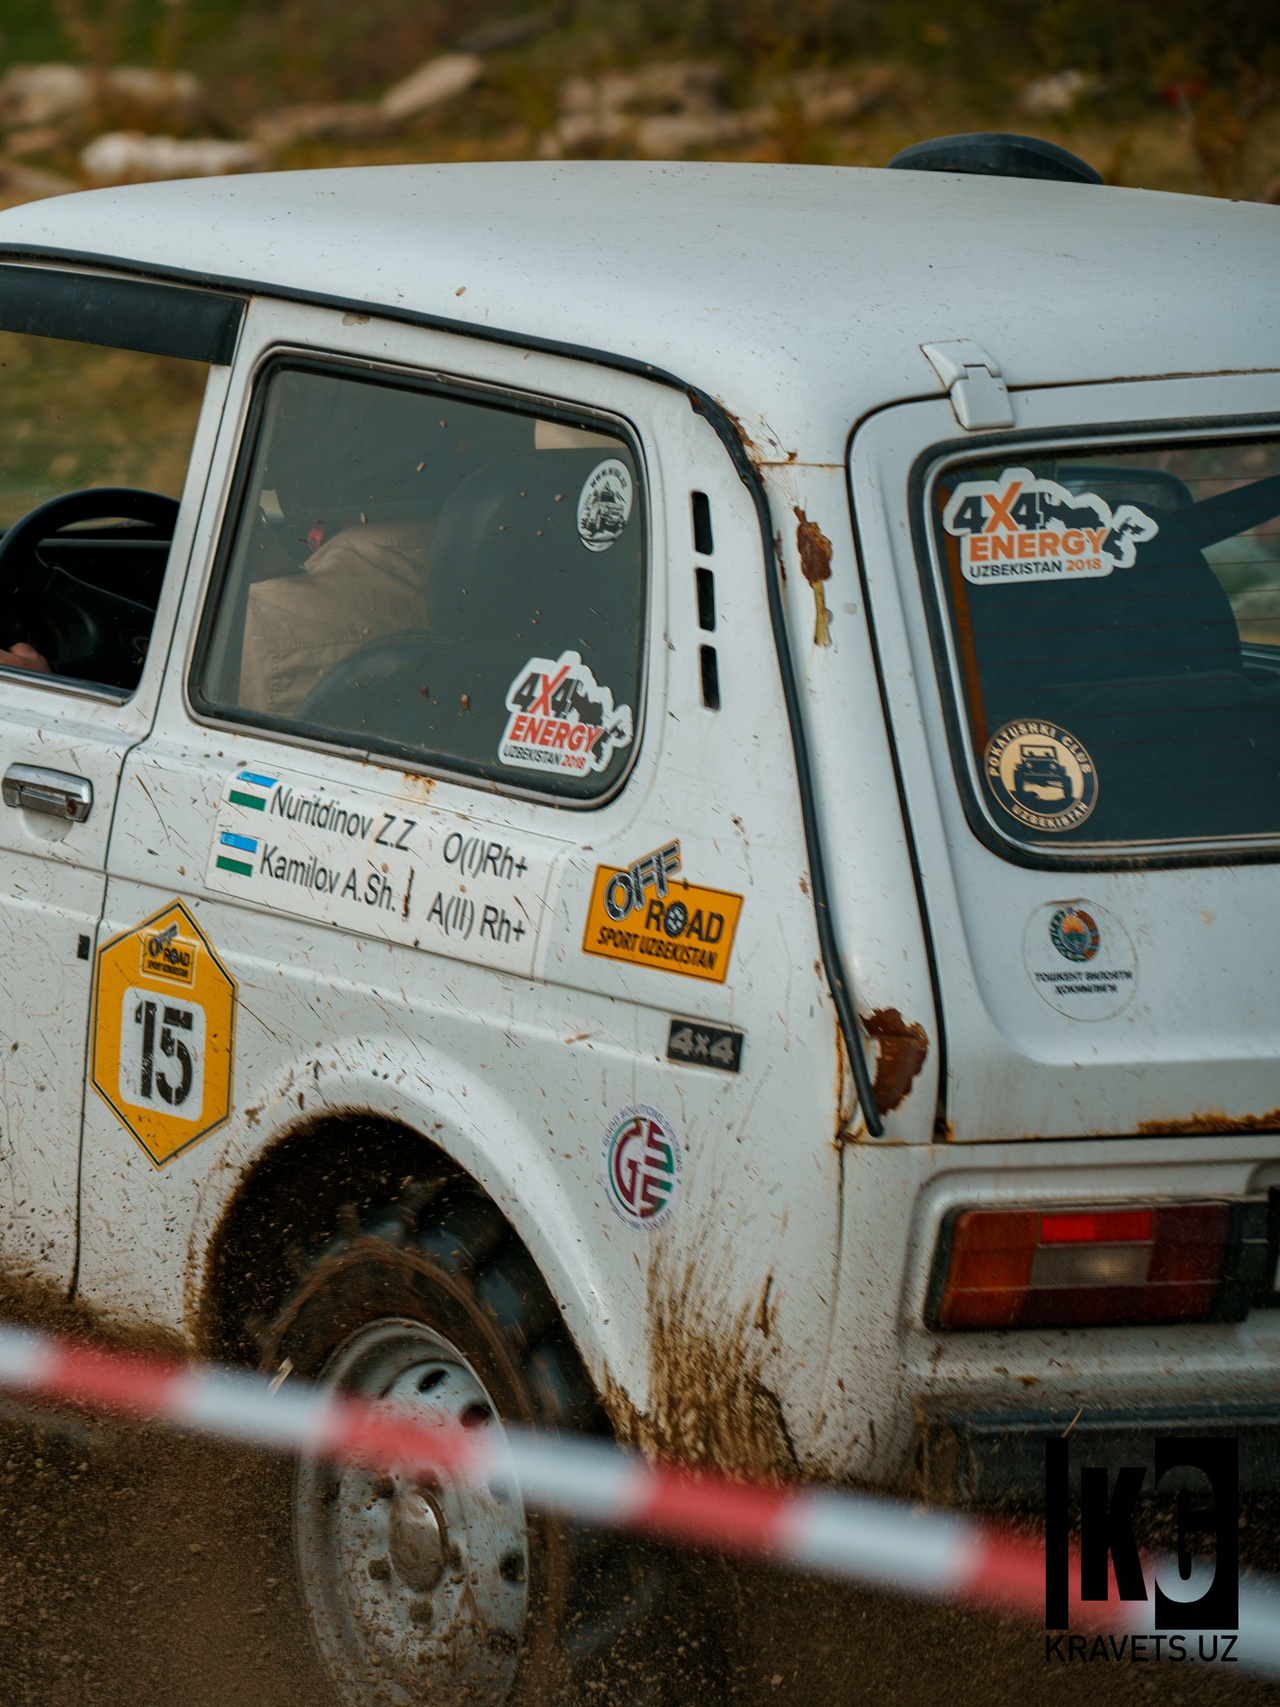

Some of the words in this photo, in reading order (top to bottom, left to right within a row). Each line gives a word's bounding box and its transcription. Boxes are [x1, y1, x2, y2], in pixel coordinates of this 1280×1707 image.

[970, 527, 1106, 561] ENERGY
[970, 561, 1062, 578] UZBEKISTAN
[1065, 558, 1101, 571] 2018
[508, 714, 605, 753] ENERGY
[503, 744, 562, 766] UZBEKISTAN
[561, 754, 587, 770] 2018
[1061, 736, 1092, 774] CLUB
[1012, 801, 1089, 829] UZBEKISTAN
[260, 843, 341, 895] Kamilov
[426, 891, 475, 941] A(II)
[480, 904, 526, 944] Rh+
[604, 842, 681, 921] OFF
[645, 899, 725, 943] ROAD
[597, 926, 639, 950] SPORT
[639, 934, 718, 971] UZBEKISTAN
[135, 1000, 193, 1106] 15
